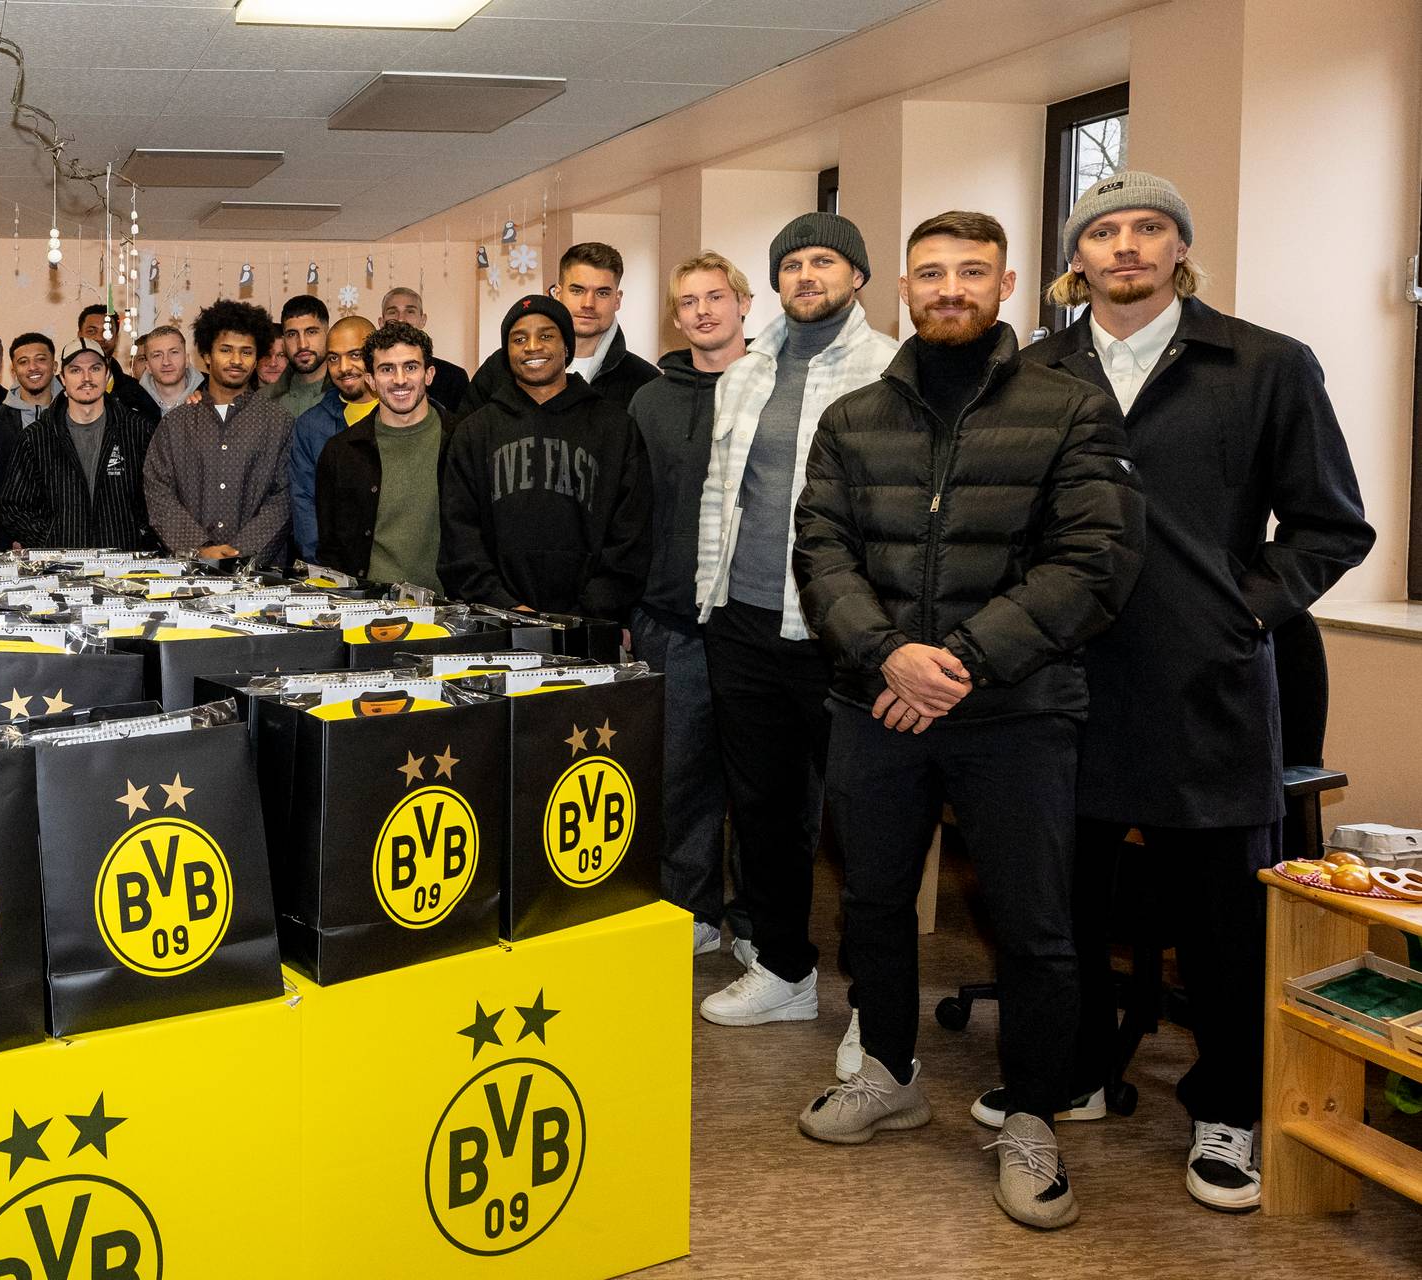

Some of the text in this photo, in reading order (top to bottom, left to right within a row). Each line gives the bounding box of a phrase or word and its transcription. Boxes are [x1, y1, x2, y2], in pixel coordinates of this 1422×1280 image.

[489, 436, 599, 511] IVE FAST
[391, 801, 467, 891] BVB
[559, 770, 625, 854] BVB
[116, 834, 218, 934] BVB
[577, 844, 603, 874] 09
[413, 882, 442, 914] 09
[152, 924, 190, 960] 09
[448, 1074, 570, 1210] BVB
[484, 1192, 529, 1240] 09
